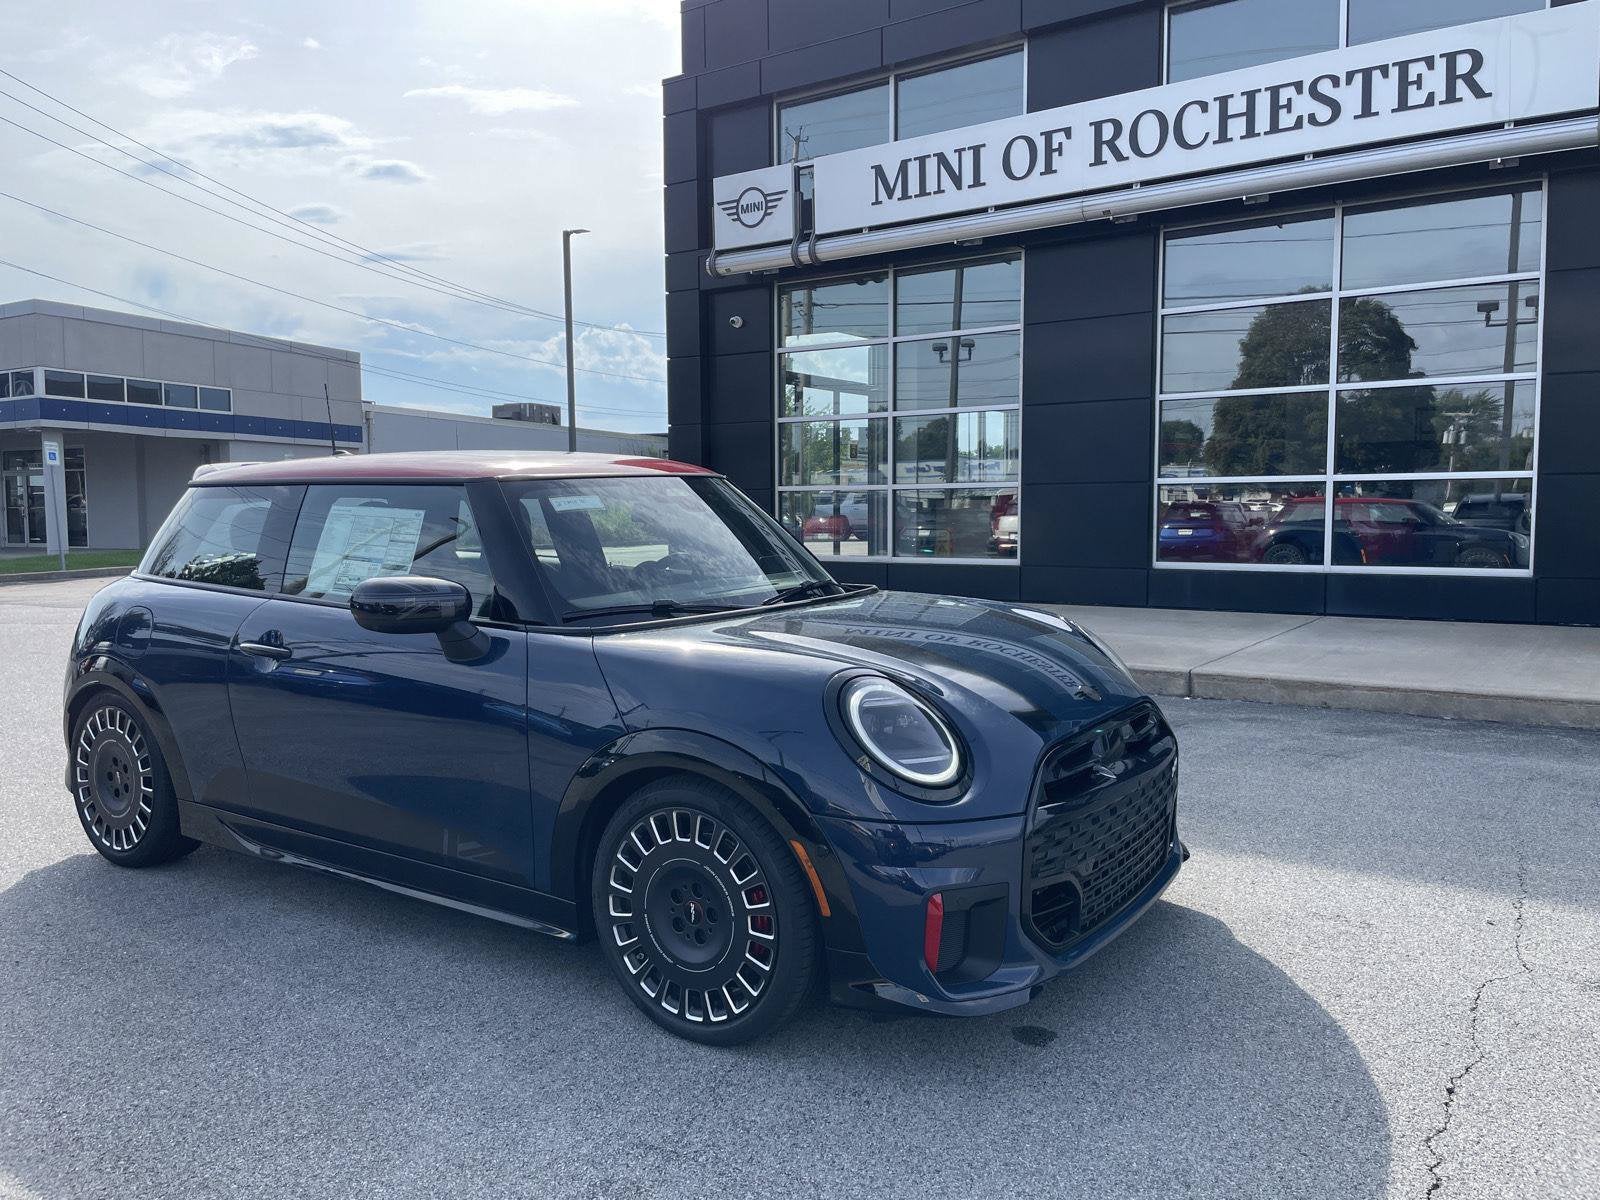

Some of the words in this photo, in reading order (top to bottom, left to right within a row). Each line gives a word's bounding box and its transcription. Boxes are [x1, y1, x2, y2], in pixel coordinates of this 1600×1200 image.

[870, 143, 986, 206] MINI
[1001, 126, 1072, 181] OF
[1088, 48, 1493, 168] ROCHESTER
[741, 201, 763, 214] MINI
